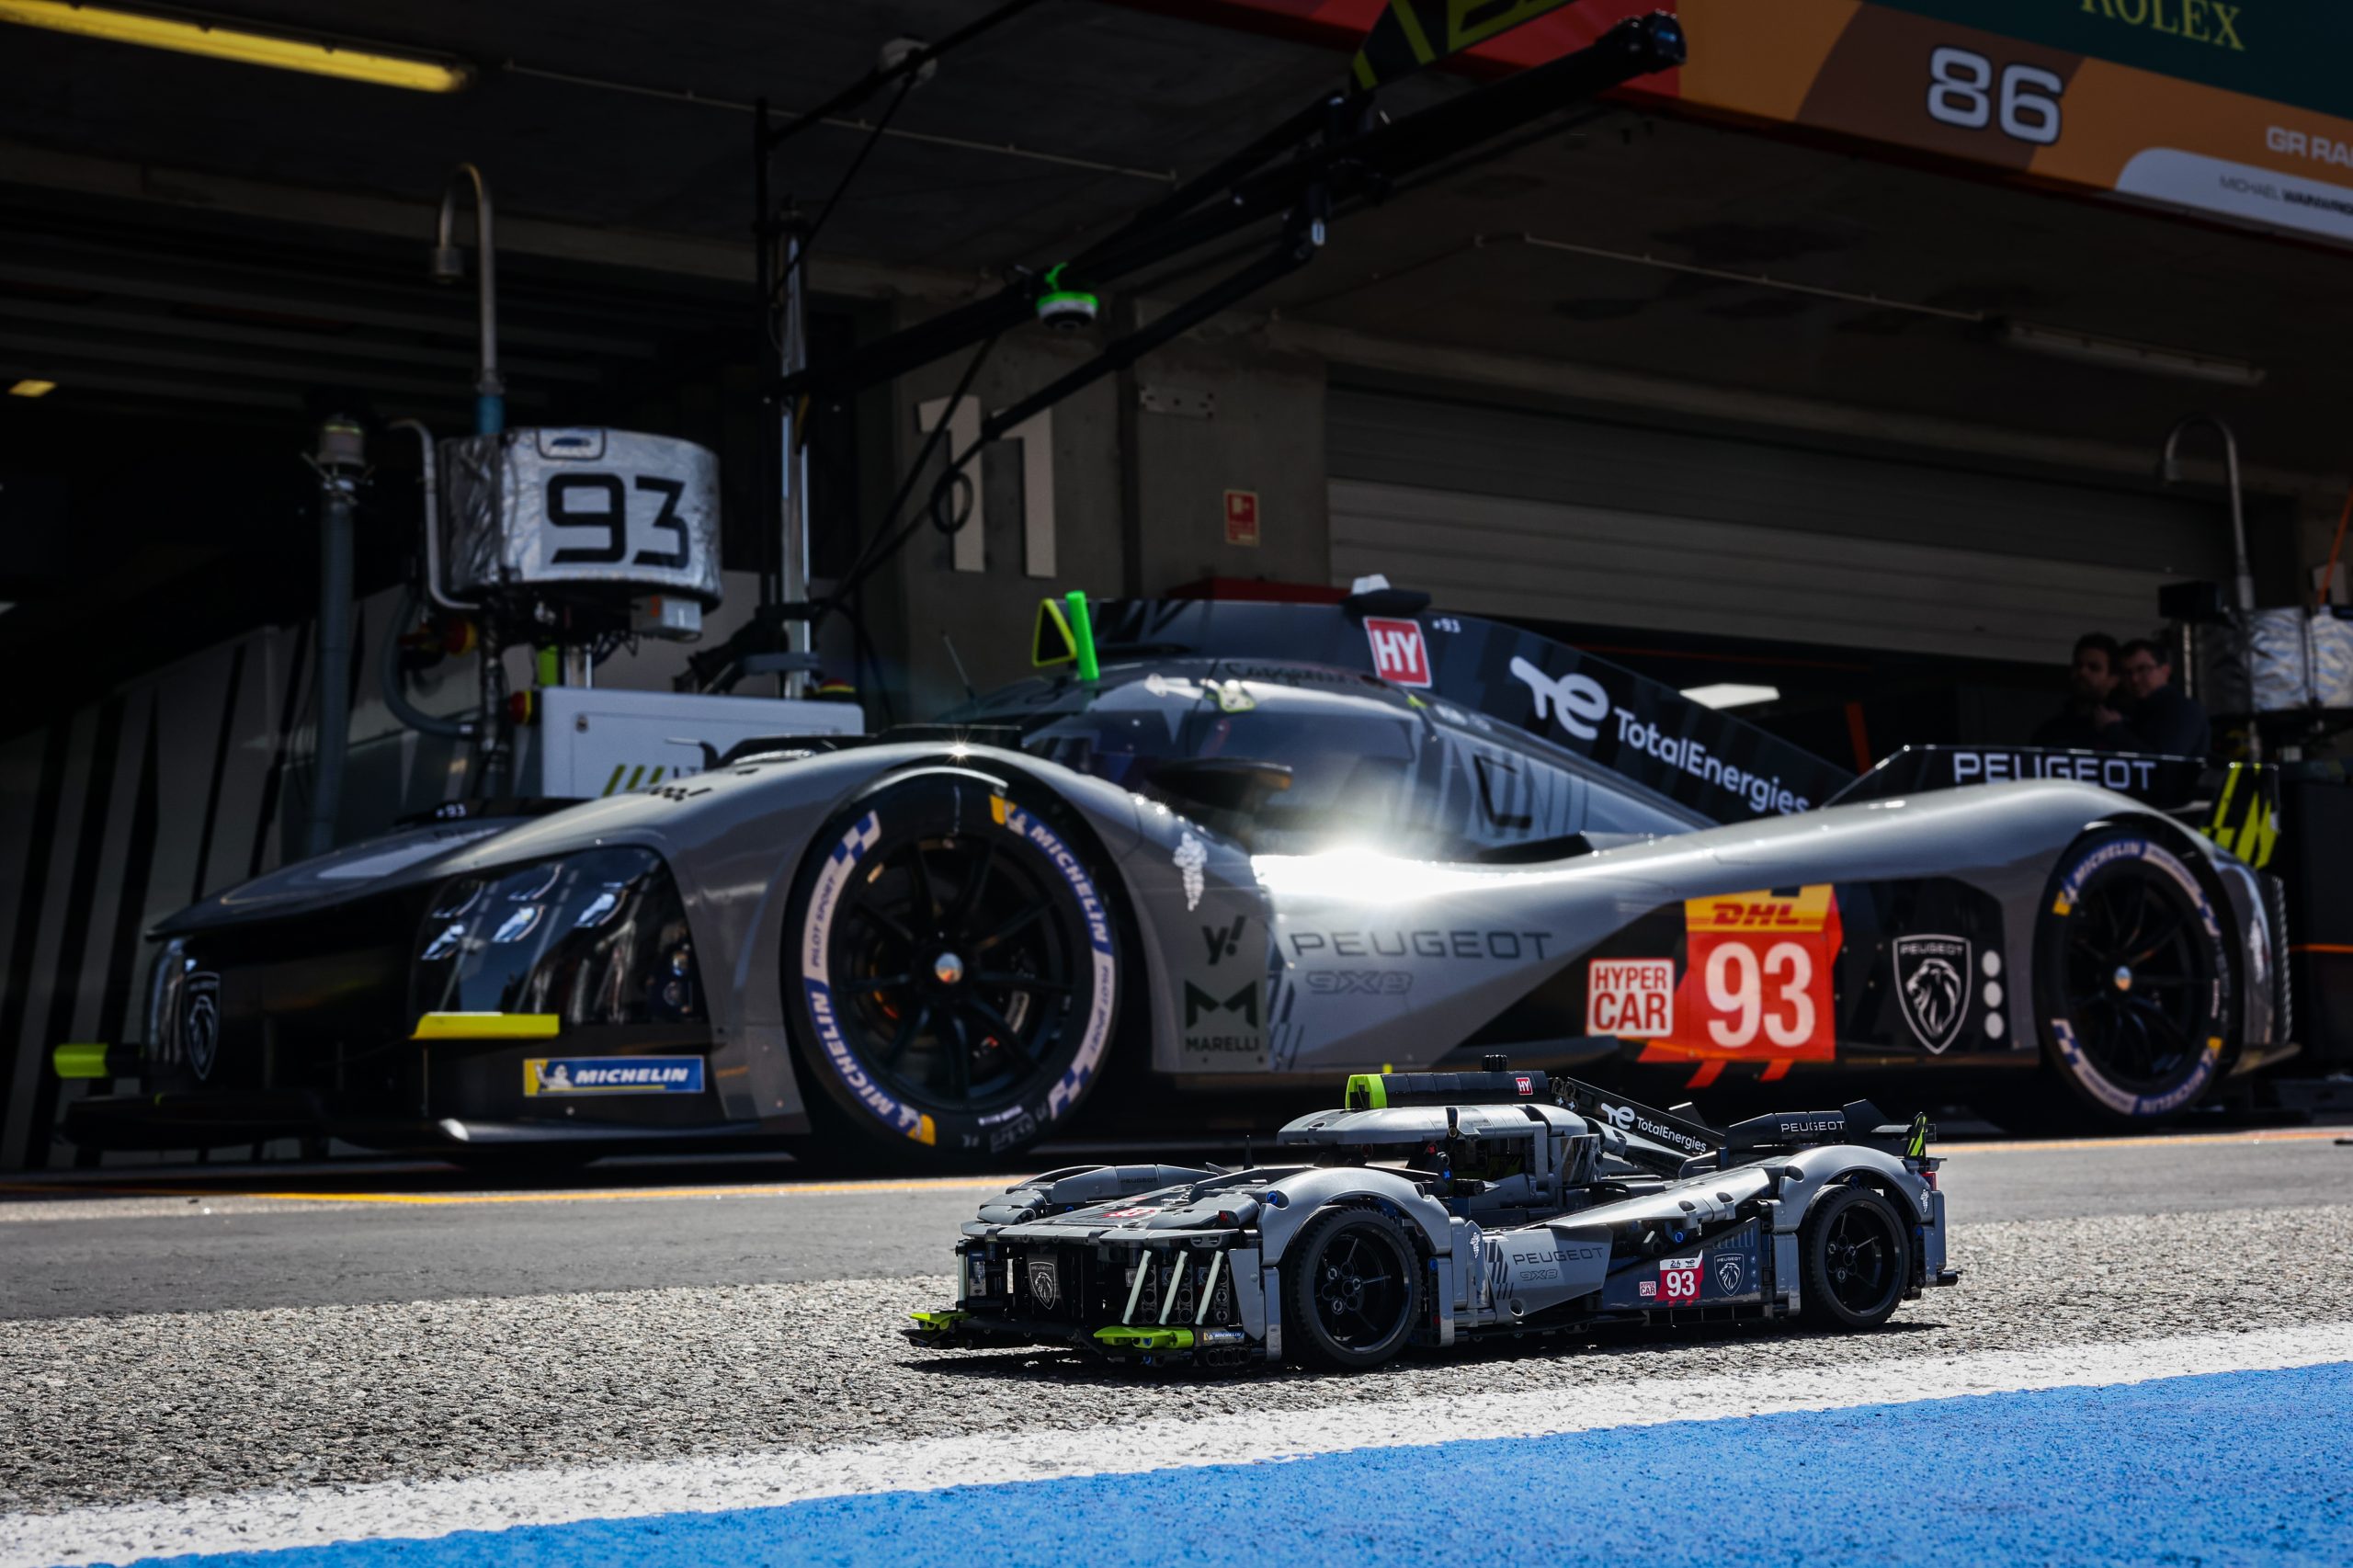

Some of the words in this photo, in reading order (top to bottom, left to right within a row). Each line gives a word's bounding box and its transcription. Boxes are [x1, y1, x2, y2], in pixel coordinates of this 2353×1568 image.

[1927, 45, 2063, 147] 86
[2265, 125, 2308, 157] GR
[547, 473, 689, 570] 93
[1372, 629, 1418, 674] HY
[1613, 705, 1811, 815] TotalEnergies
[1952, 752, 2158, 791] PEUGEOT
[1029, 824, 1109, 943] MICHELIN
[1711, 903, 1802, 926] DHL
[1290, 930, 1553, 960] PEUGEOT
[1899, 942, 1964, 955] PEUGEOT
[1594, 967, 1668, 990] HYPER
[1704, 941, 1816, 1049] 93
[1593, 992, 1667, 1031] CAR
[811, 991, 895, 1117] MICHELIN
[1185, 1035, 1260, 1052] MARELLI
[574, 1067, 689, 1085] MICHELIN
[1518, 1080, 1530, 1092] HY
[1636, 1116, 1707, 1153] TotalEnergies
[1780, 1120, 1845, 1132] PEUGEOT
[1512, 1247, 1604, 1265] PEUGEOT
[1640, 1287, 1656, 1296] CAR
[1666, 1270, 1696, 1297] 93
